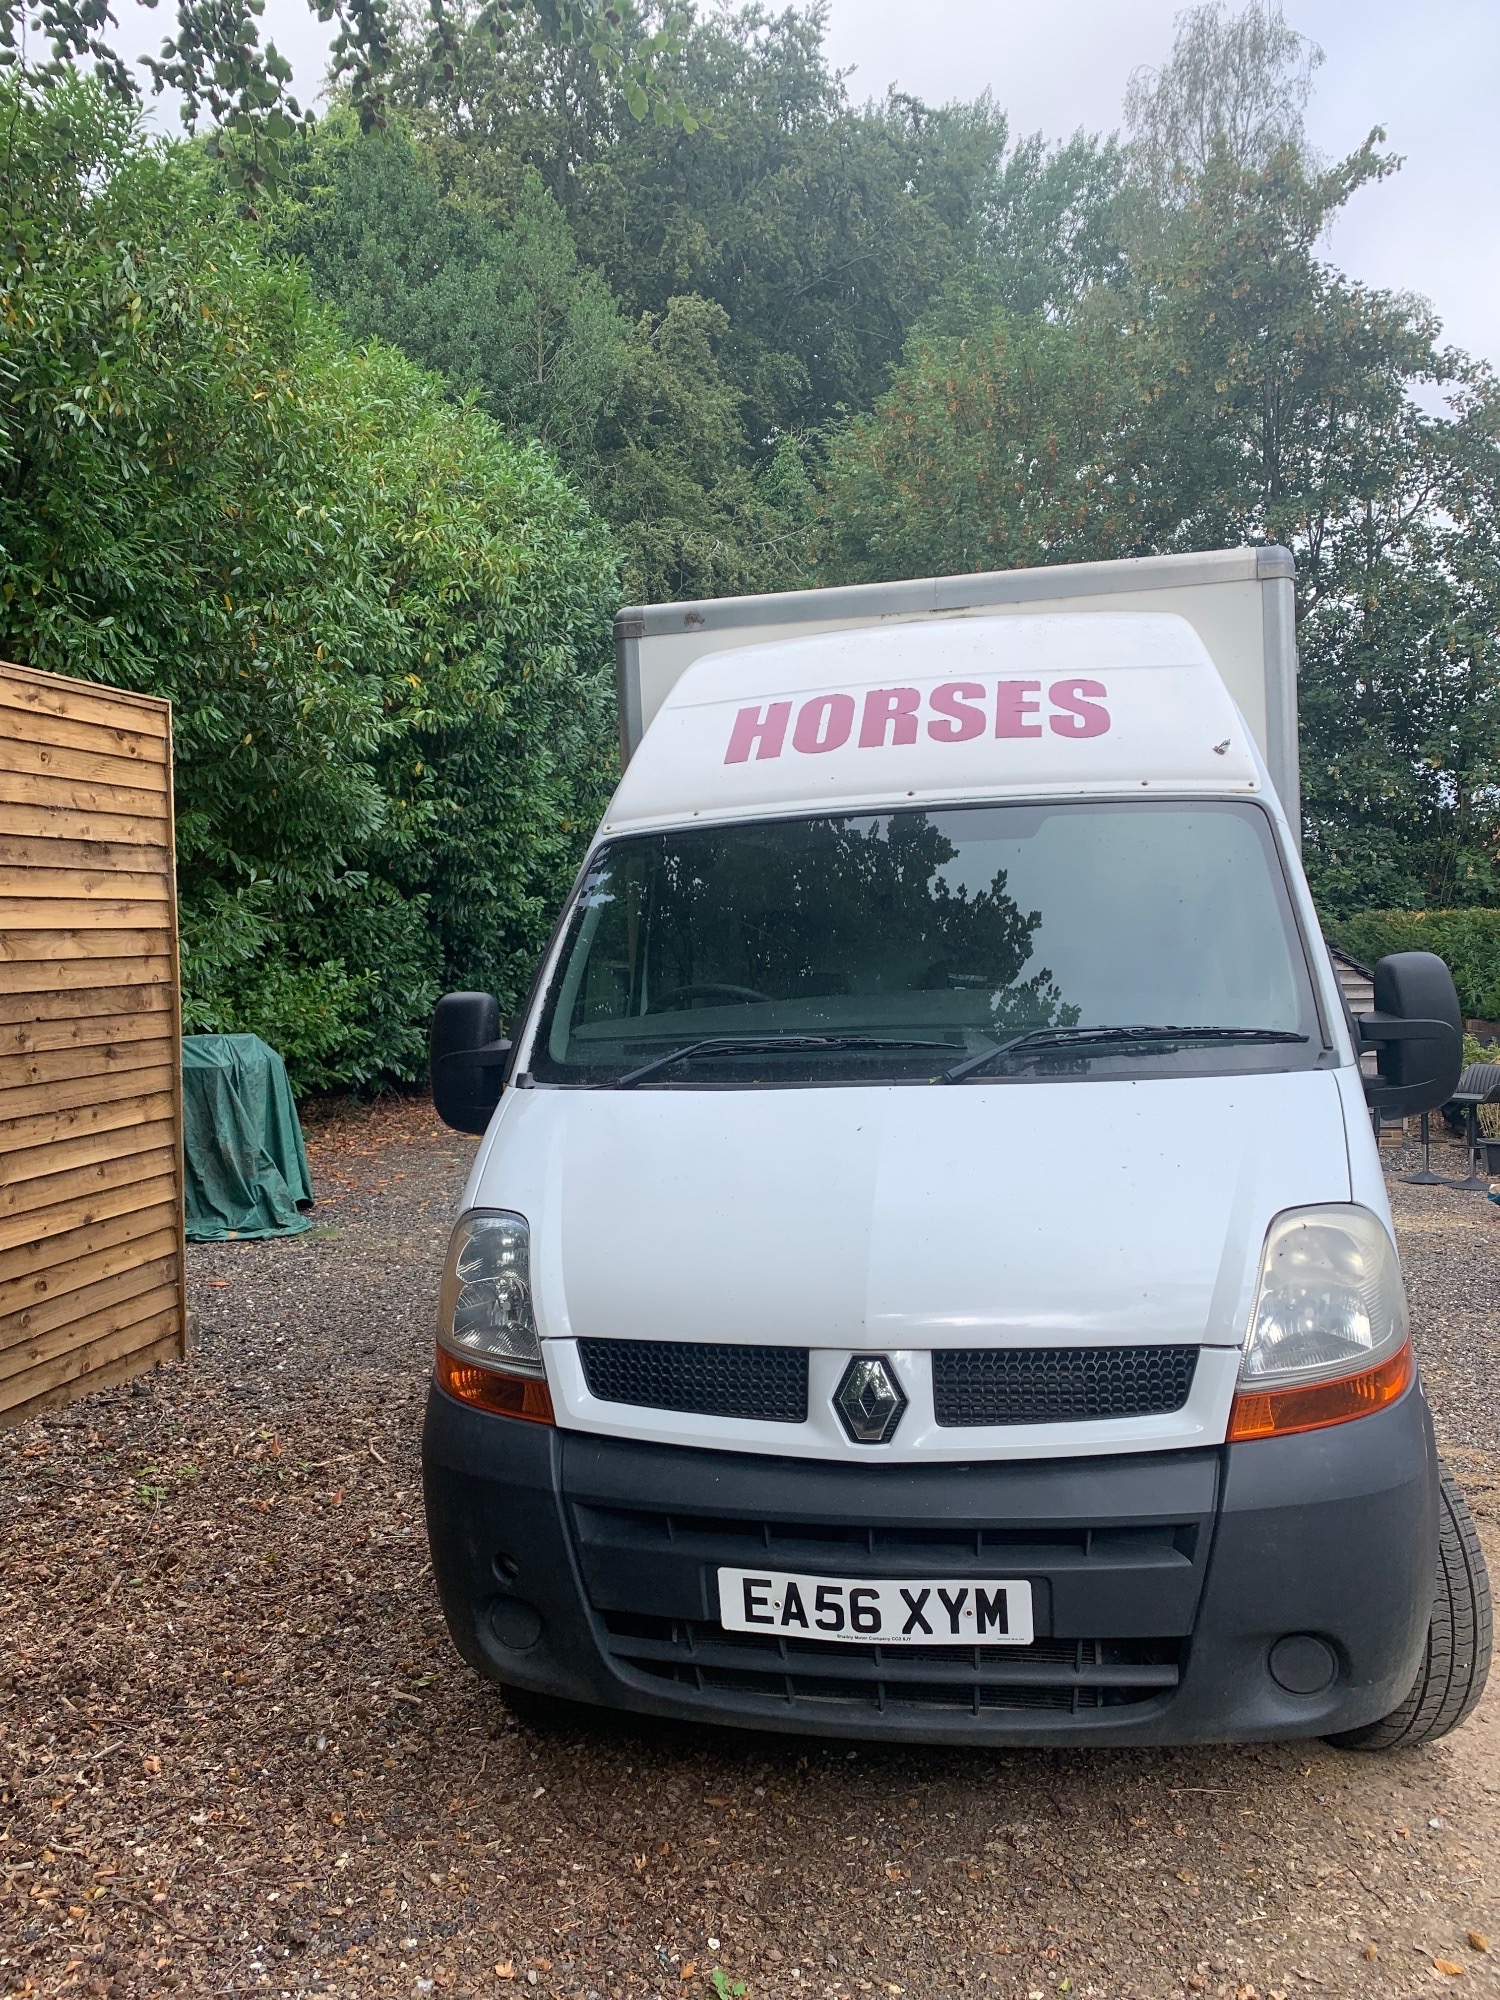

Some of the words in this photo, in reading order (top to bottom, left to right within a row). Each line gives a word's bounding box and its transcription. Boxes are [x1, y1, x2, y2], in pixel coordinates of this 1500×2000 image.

[724, 679, 1111, 764] HORSES
[742, 1577, 882, 1634] EA56
[899, 1588, 1009, 1635] XYM
